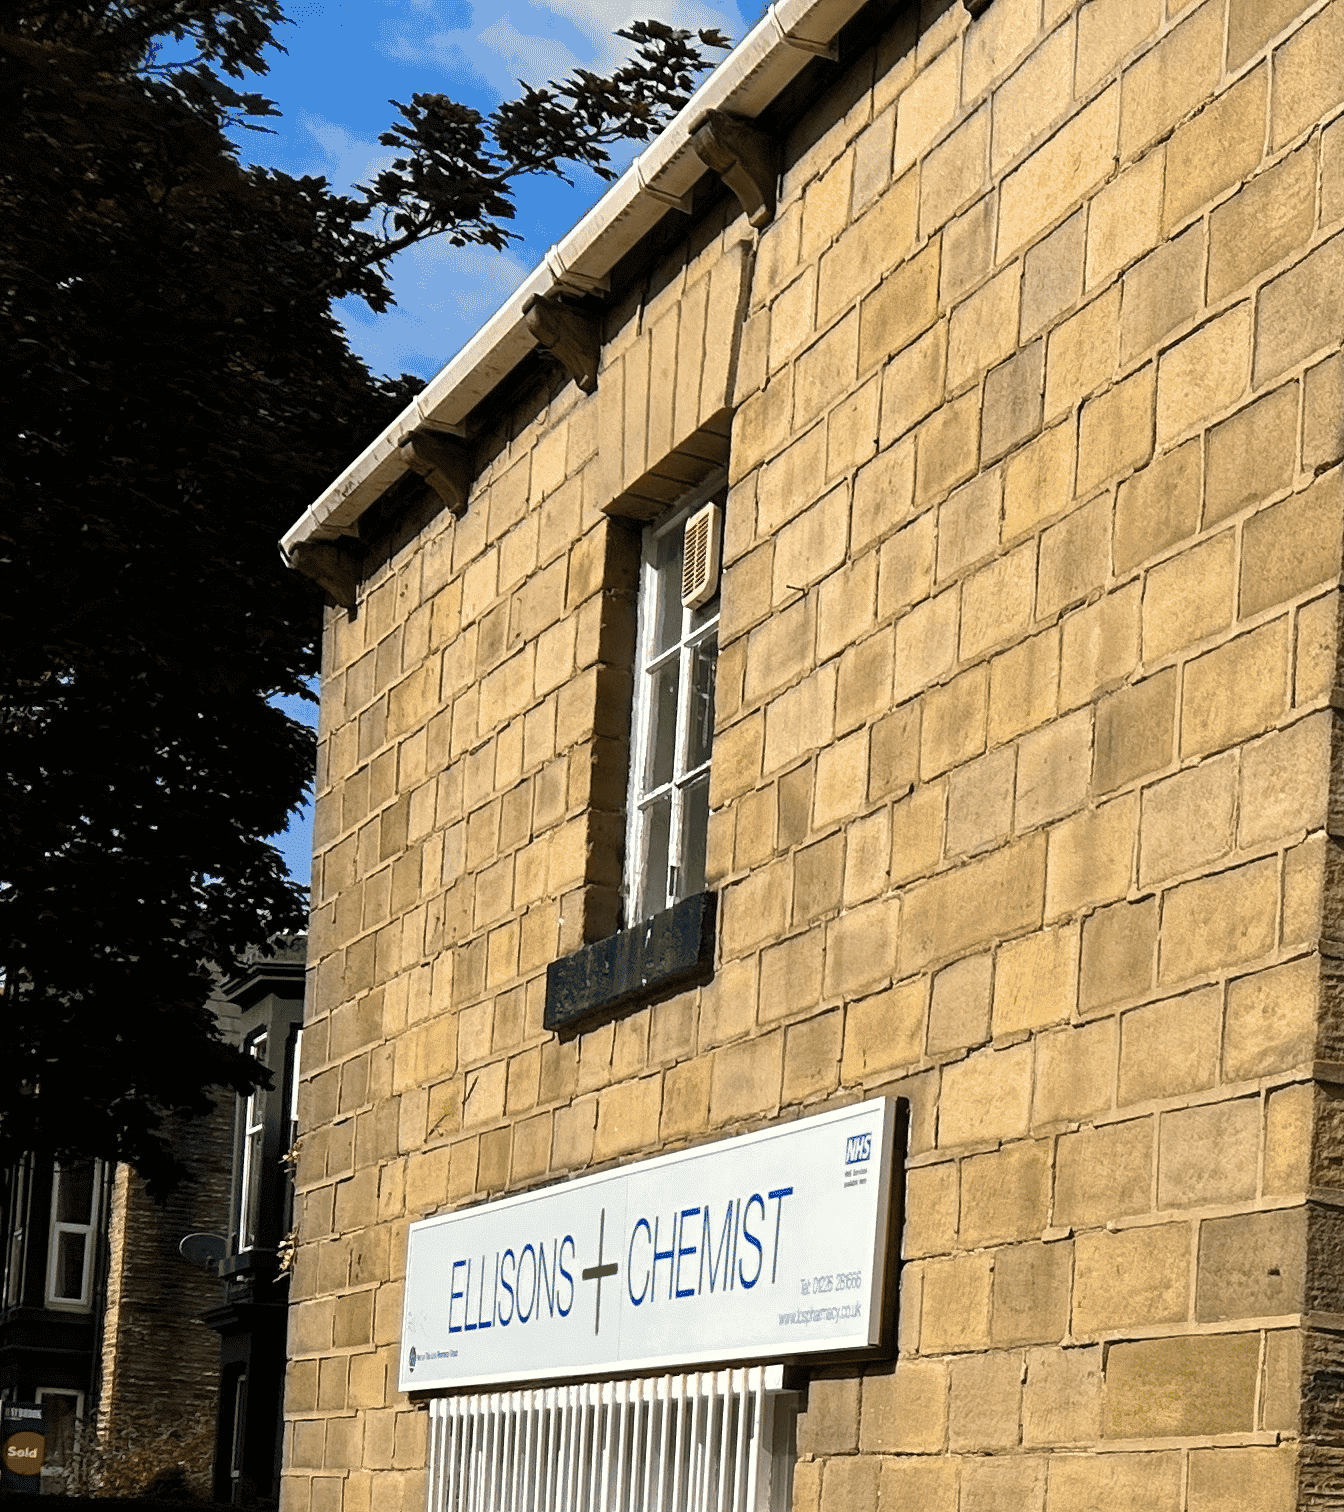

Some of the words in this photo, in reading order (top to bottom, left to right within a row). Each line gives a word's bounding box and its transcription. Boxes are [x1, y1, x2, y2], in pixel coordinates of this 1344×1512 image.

[846, 1133, 871, 1164] NHS
[448, 1234, 576, 1334] ELLISONS
[627, 1186, 794, 1307] CHEMIST
[7, 1446, 38, 1459] Sold
